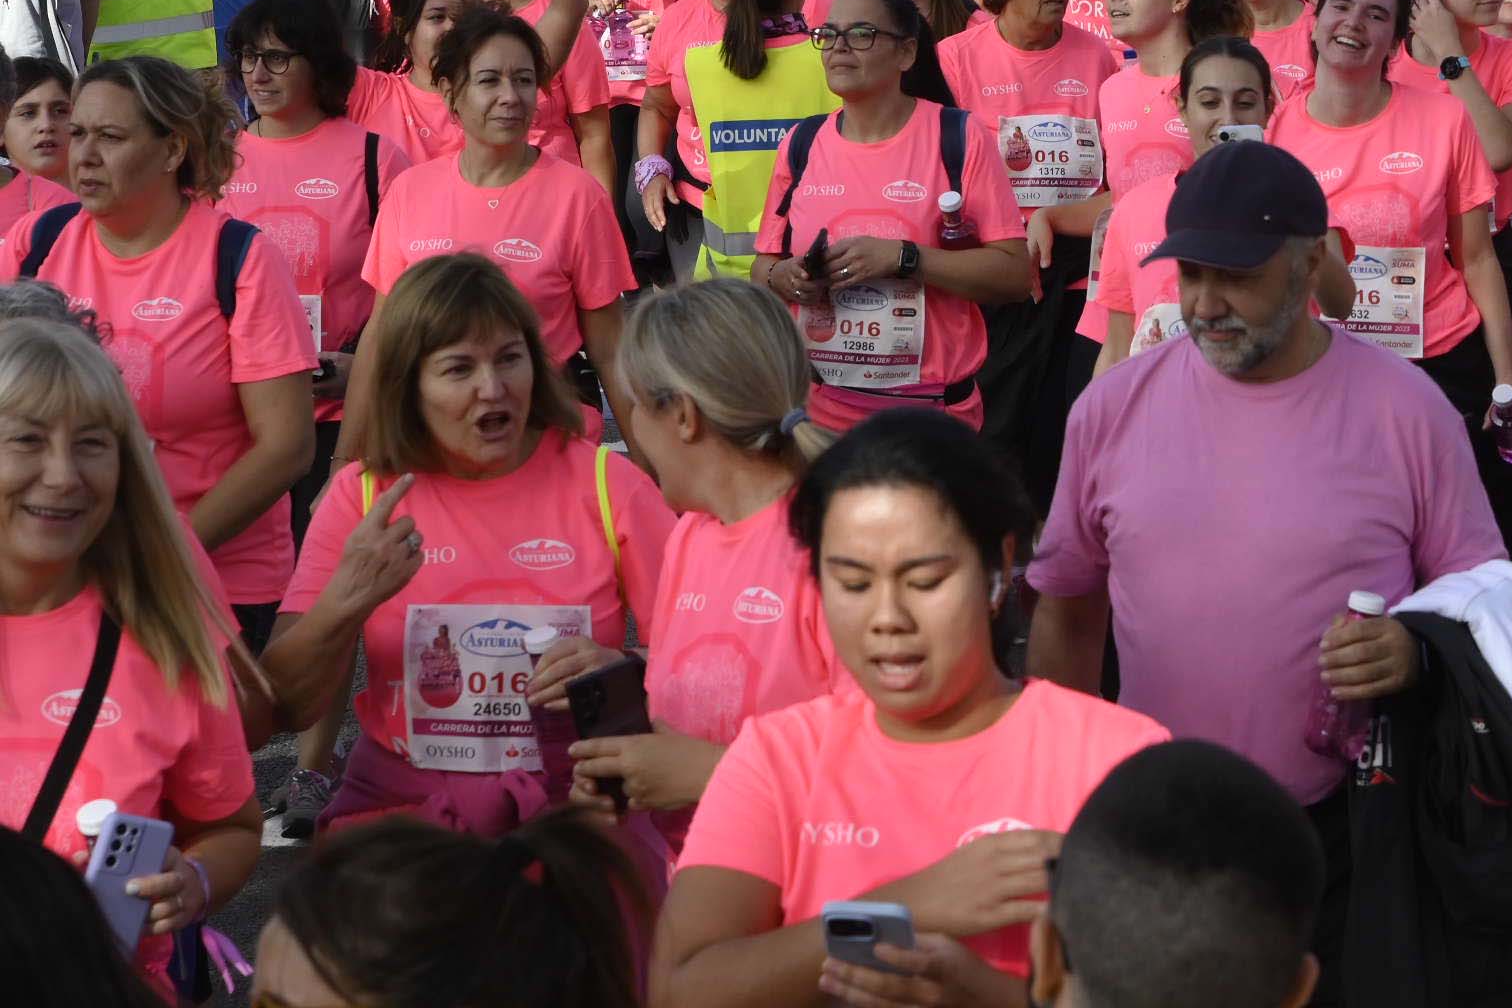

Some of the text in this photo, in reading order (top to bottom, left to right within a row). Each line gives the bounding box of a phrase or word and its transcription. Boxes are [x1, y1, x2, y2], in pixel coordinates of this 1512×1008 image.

[982, 82, 1023, 97] OYSHO
[1107, 119, 1138, 132] OYSHO
[712, 127, 788, 145] VOLUNTA
[1031, 129, 1071, 138] ASTURIANA
[1034, 150, 1070, 164] 016
[1038, 167, 1066, 176] 13178
[298, 185, 336, 195] ASTURIANA
[409, 238, 453, 252] OYSHO
[497, 245, 540, 259] ASTURIANA
[839, 289, 885, 306] ASTURIANA
[1356, 290, 1381, 305] 16
[839, 319, 881, 337] 016
[843, 340, 875, 352] 12986
[810, 351, 844, 361] CARRERA
[844, 354, 855, 362] DE
[855, 355, 866, 363] LA
[867, 355, 891, 364] MUJER
[514, 550, 571, 563] ASTURIANA
[467, 671, 529, 694] 016
[473, 702, 522, 717] 24650
[430, 722, 476, 733] CARRERA
[477, 723, 491, 733] DE
[493, 723, 508, 733] LA
[425, 744, 476, 760] OYSHO
